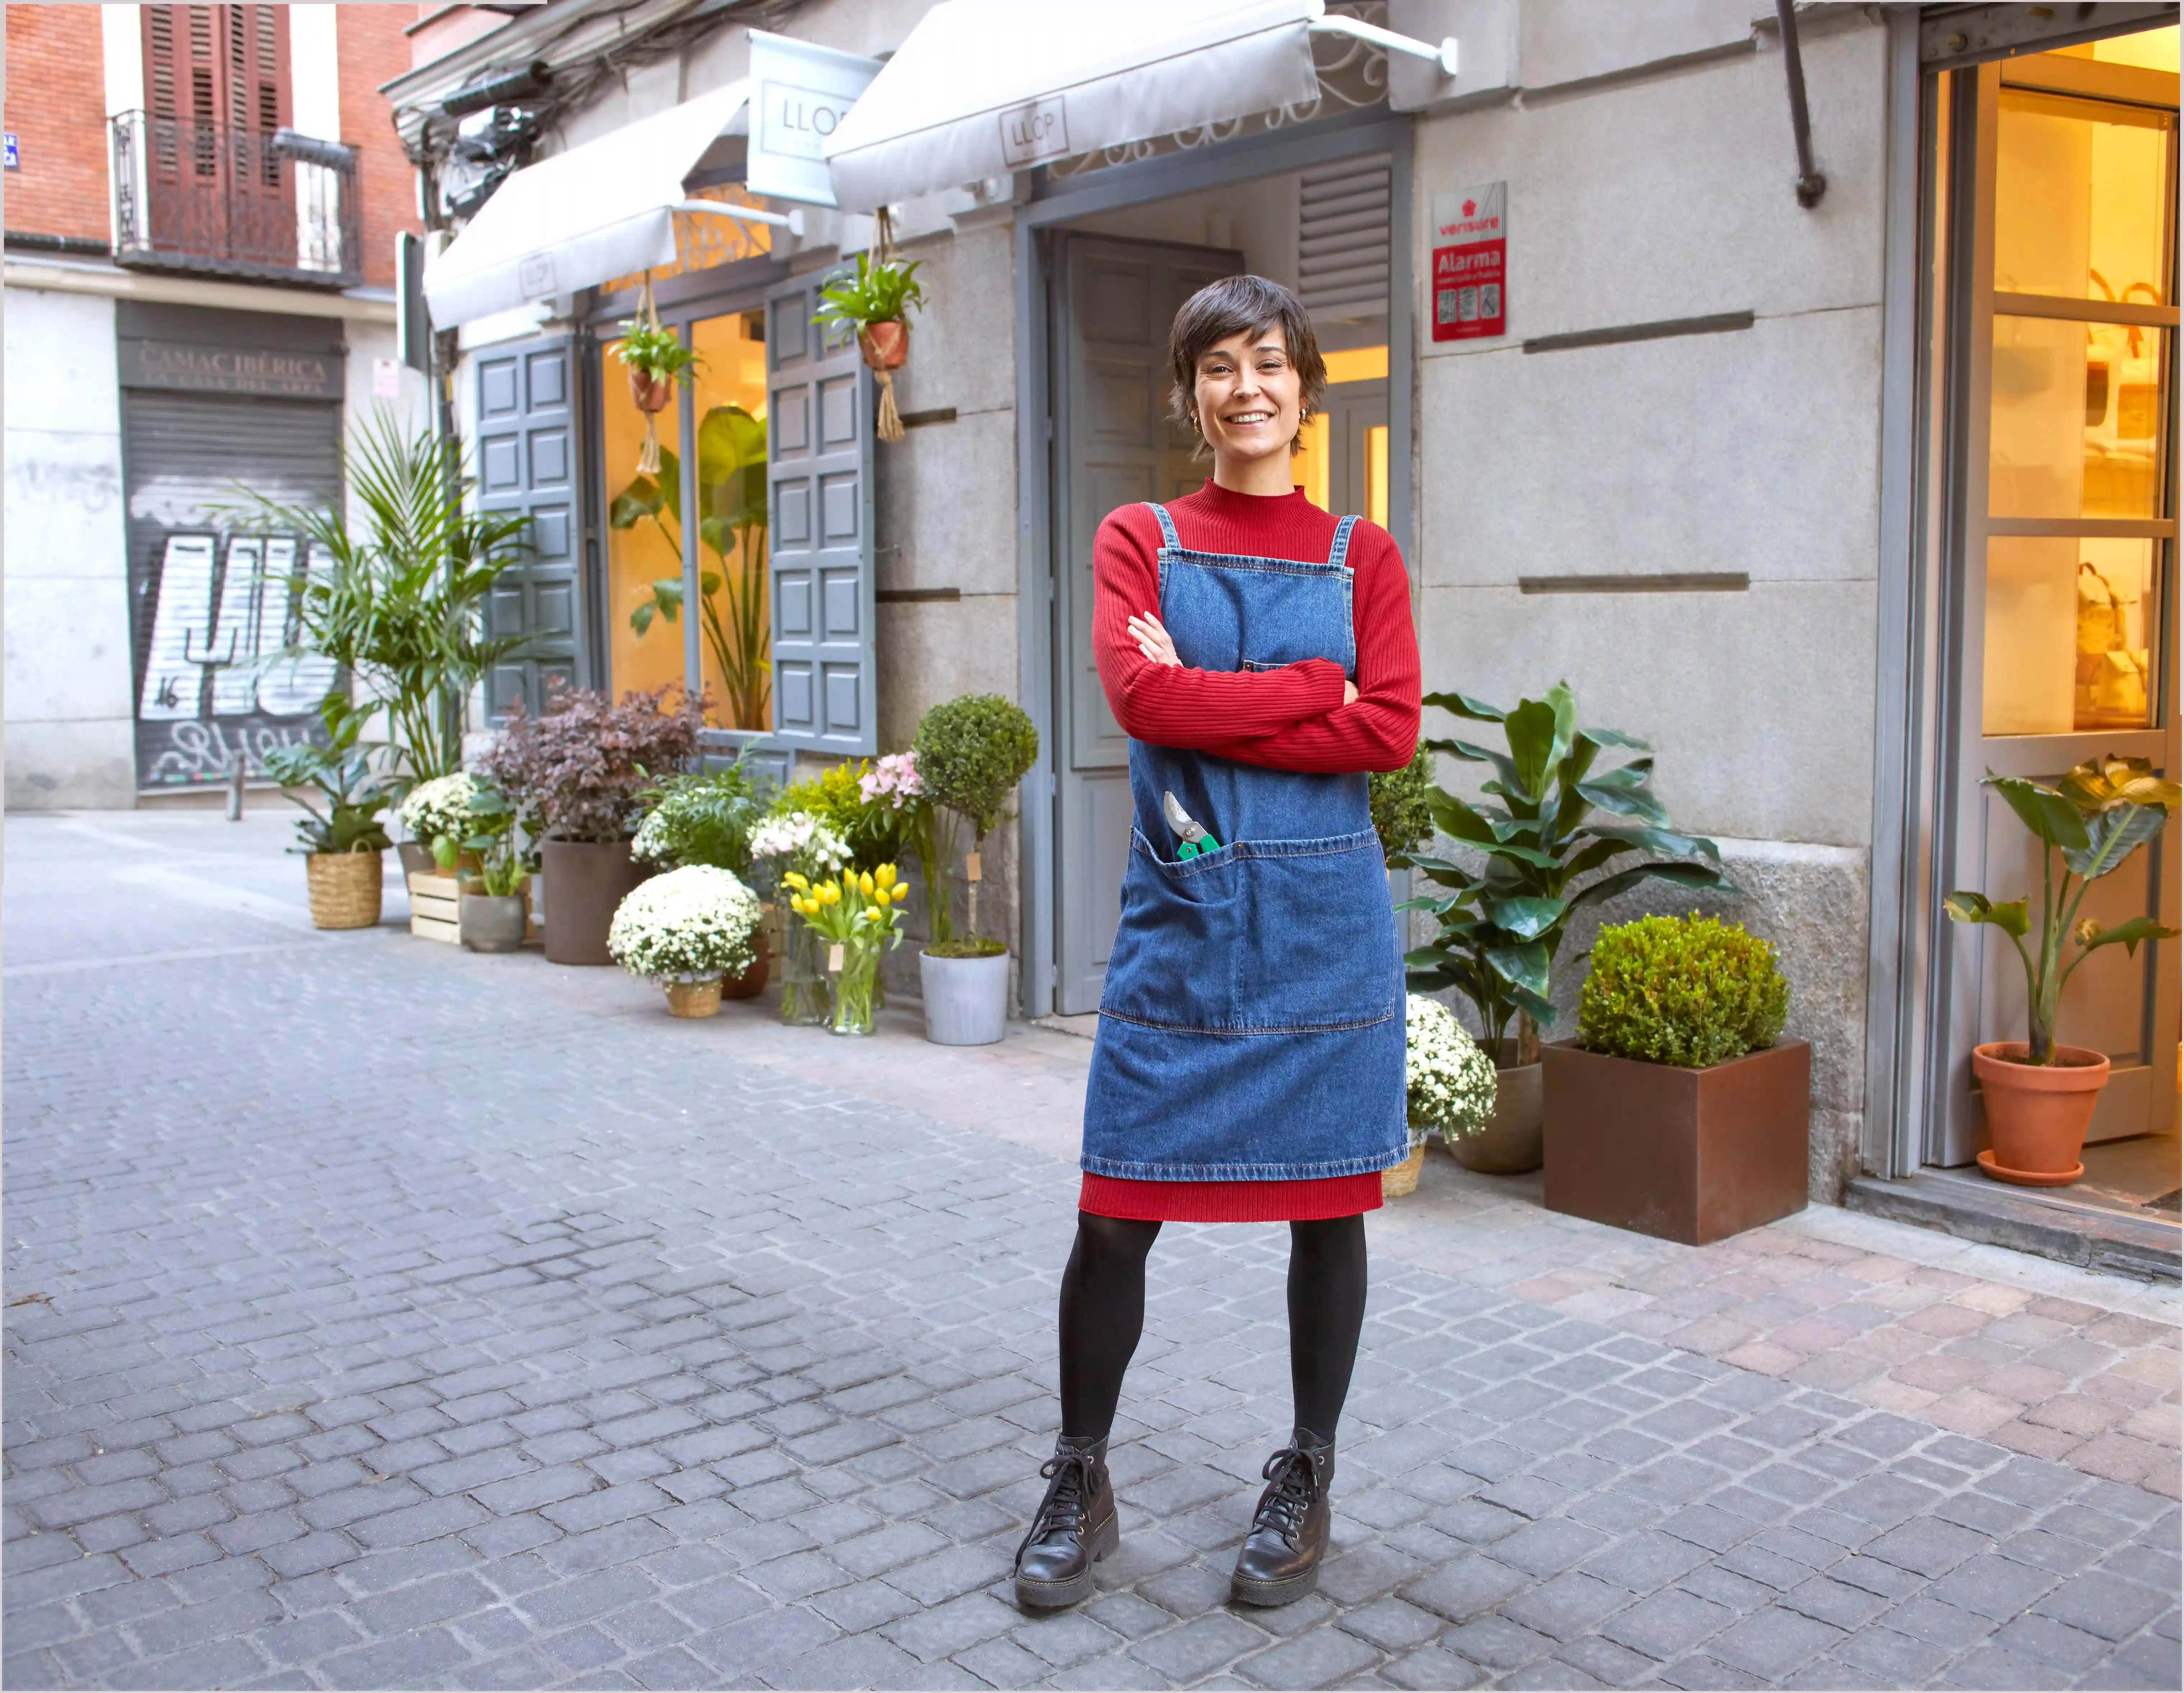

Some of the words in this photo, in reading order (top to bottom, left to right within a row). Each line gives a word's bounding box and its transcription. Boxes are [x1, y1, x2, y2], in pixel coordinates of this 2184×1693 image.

[784, 99, 847, 136] LLO
[1011, 113, 1054, 146] LLOP
[1439, 217, 1499, 236] verisure
[1438, 251, 1500, 274] Alarma
[139, 348, 229, 372] CAMAC
[234, 351, 325, 379] IBÉRICA
